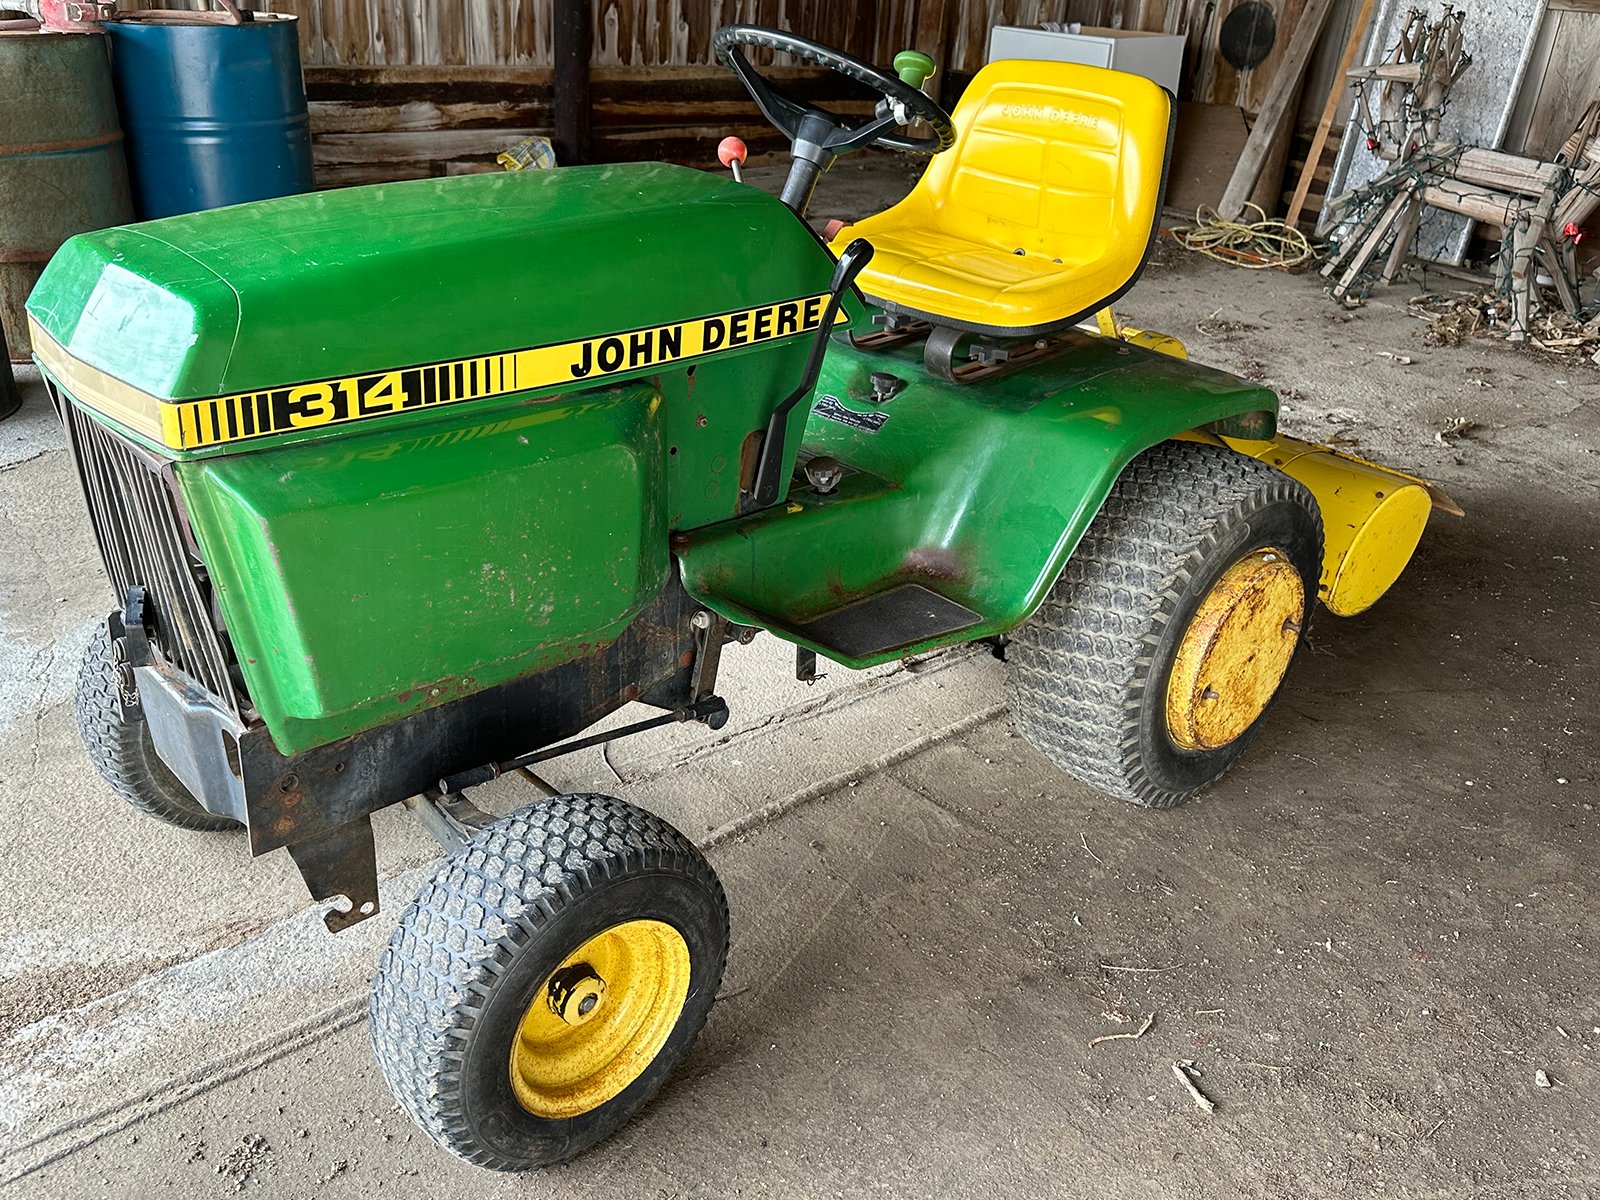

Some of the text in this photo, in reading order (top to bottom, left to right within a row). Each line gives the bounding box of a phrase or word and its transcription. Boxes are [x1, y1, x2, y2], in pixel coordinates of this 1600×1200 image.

[1002, 103, 1099, 129] JOHN DEERE
[287, 297, 821, 427] 314 JOHN DEERE
